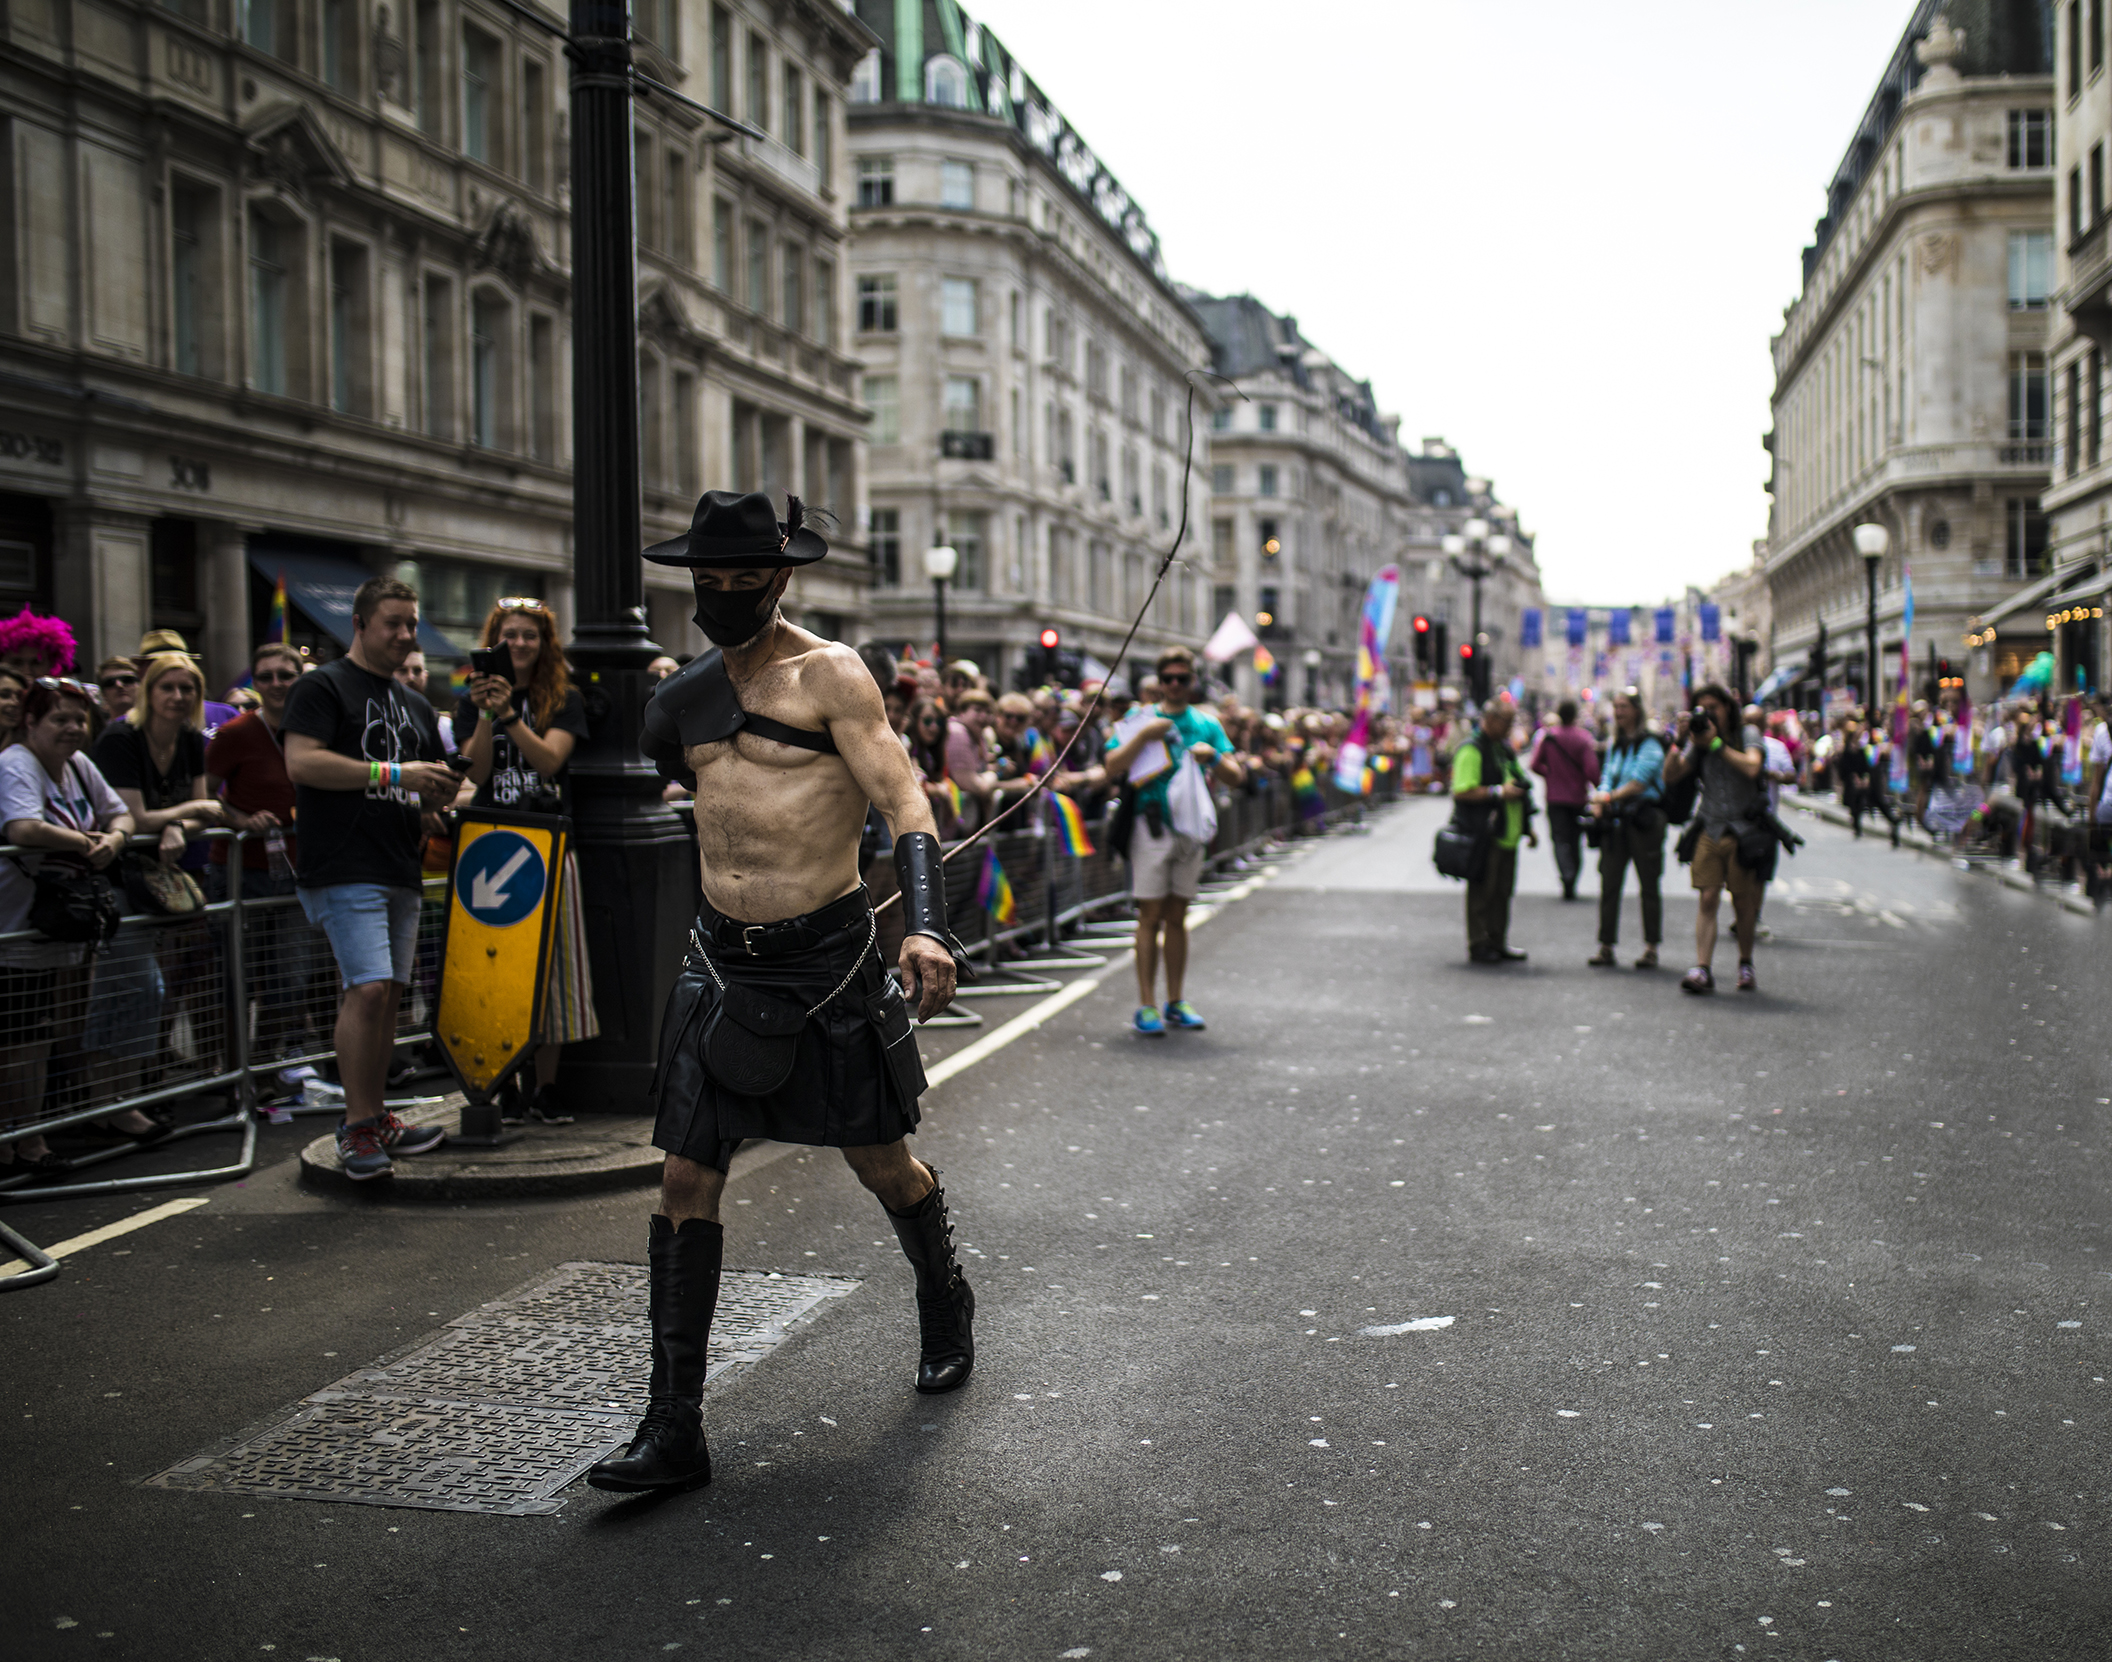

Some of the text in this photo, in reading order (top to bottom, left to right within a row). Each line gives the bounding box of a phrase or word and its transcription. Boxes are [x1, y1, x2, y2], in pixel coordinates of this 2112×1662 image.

[493, 771, 538, 788] PRIDE
[365, 785, 421, 808] LOND
[419, 1463, 463, 1482] COLT
